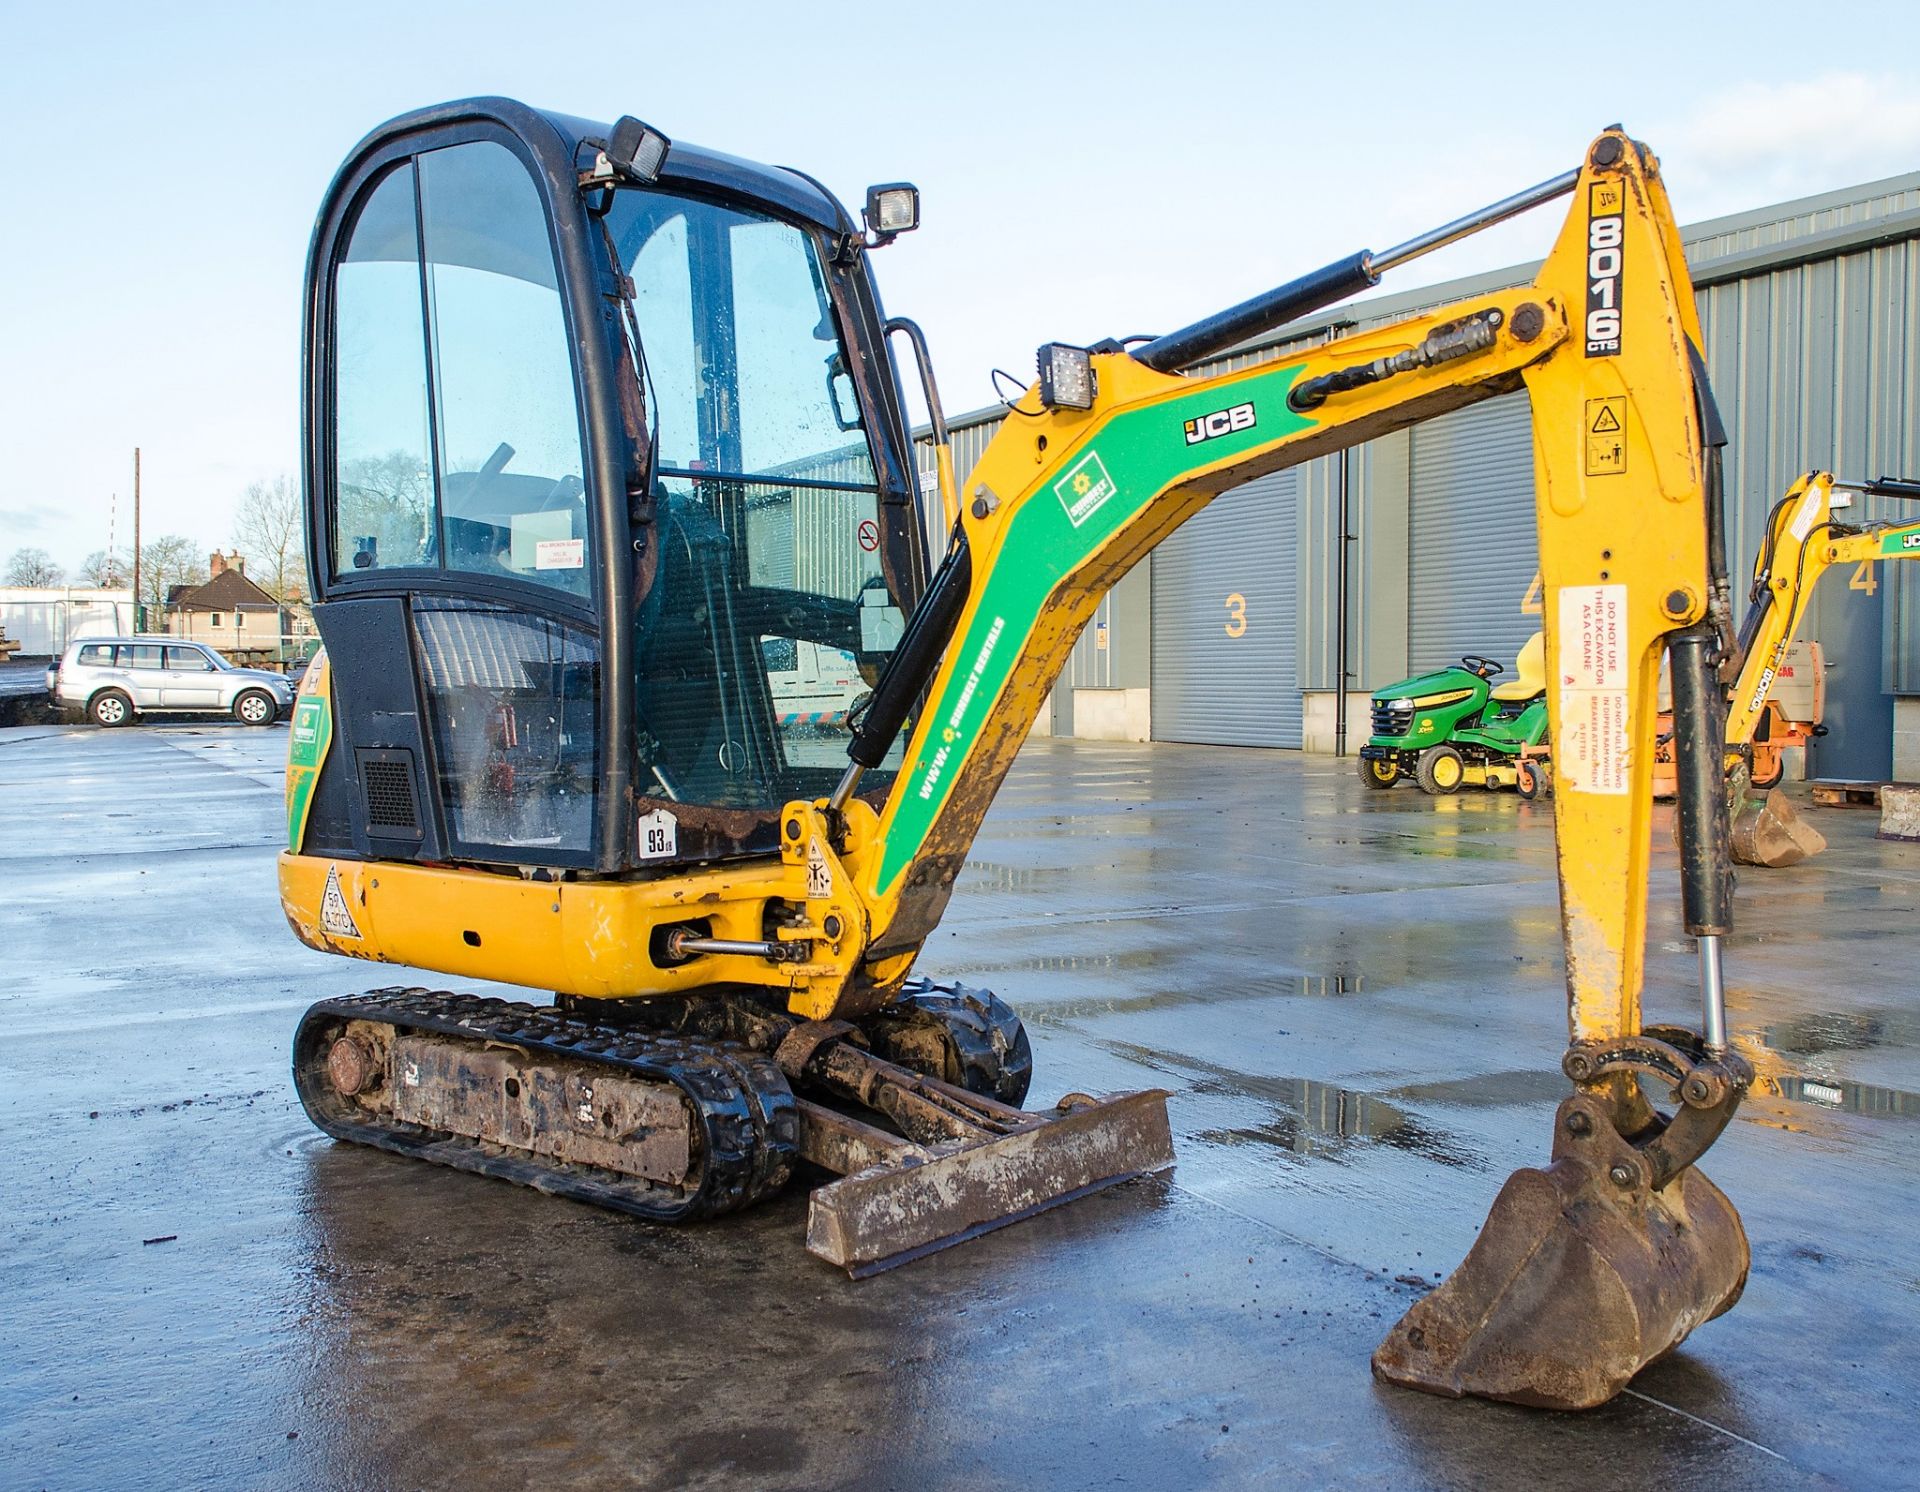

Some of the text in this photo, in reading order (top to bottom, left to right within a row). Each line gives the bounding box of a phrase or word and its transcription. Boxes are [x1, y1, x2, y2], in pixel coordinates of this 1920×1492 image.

[1586, 217, 1622, 341] 8016
[1586, 340, 1619, 352] CTS
[1184, 403, 1256, 444] JCB
[1903, 534, 1920, 548] JC
[1849, 560, 1877, 596] 4
[1224, 593, 1247, 638] 3
[1583, 604, 1592, 672] AS A CRANE
[1595, 590, 1605, 685] THIS EXCAVATOR
[1608, 602, 1617, 672] DO NOT USE
[1777, 666, 1794, 677] CAG
[1591, 696, 1599, 732] BREAKER
[1614, 696, 1622, 709] DO
[1614, 710, 1622, 729] NOT
[1579, 732, 1587, 760] FITTED
[1602, 696, 1610, 788] IN DIPPER RAM WHILST
[1614, 731, 1622, 755] FULLY
[656, 815, 662, 823] L
[648, 829, 665, 853] 93
